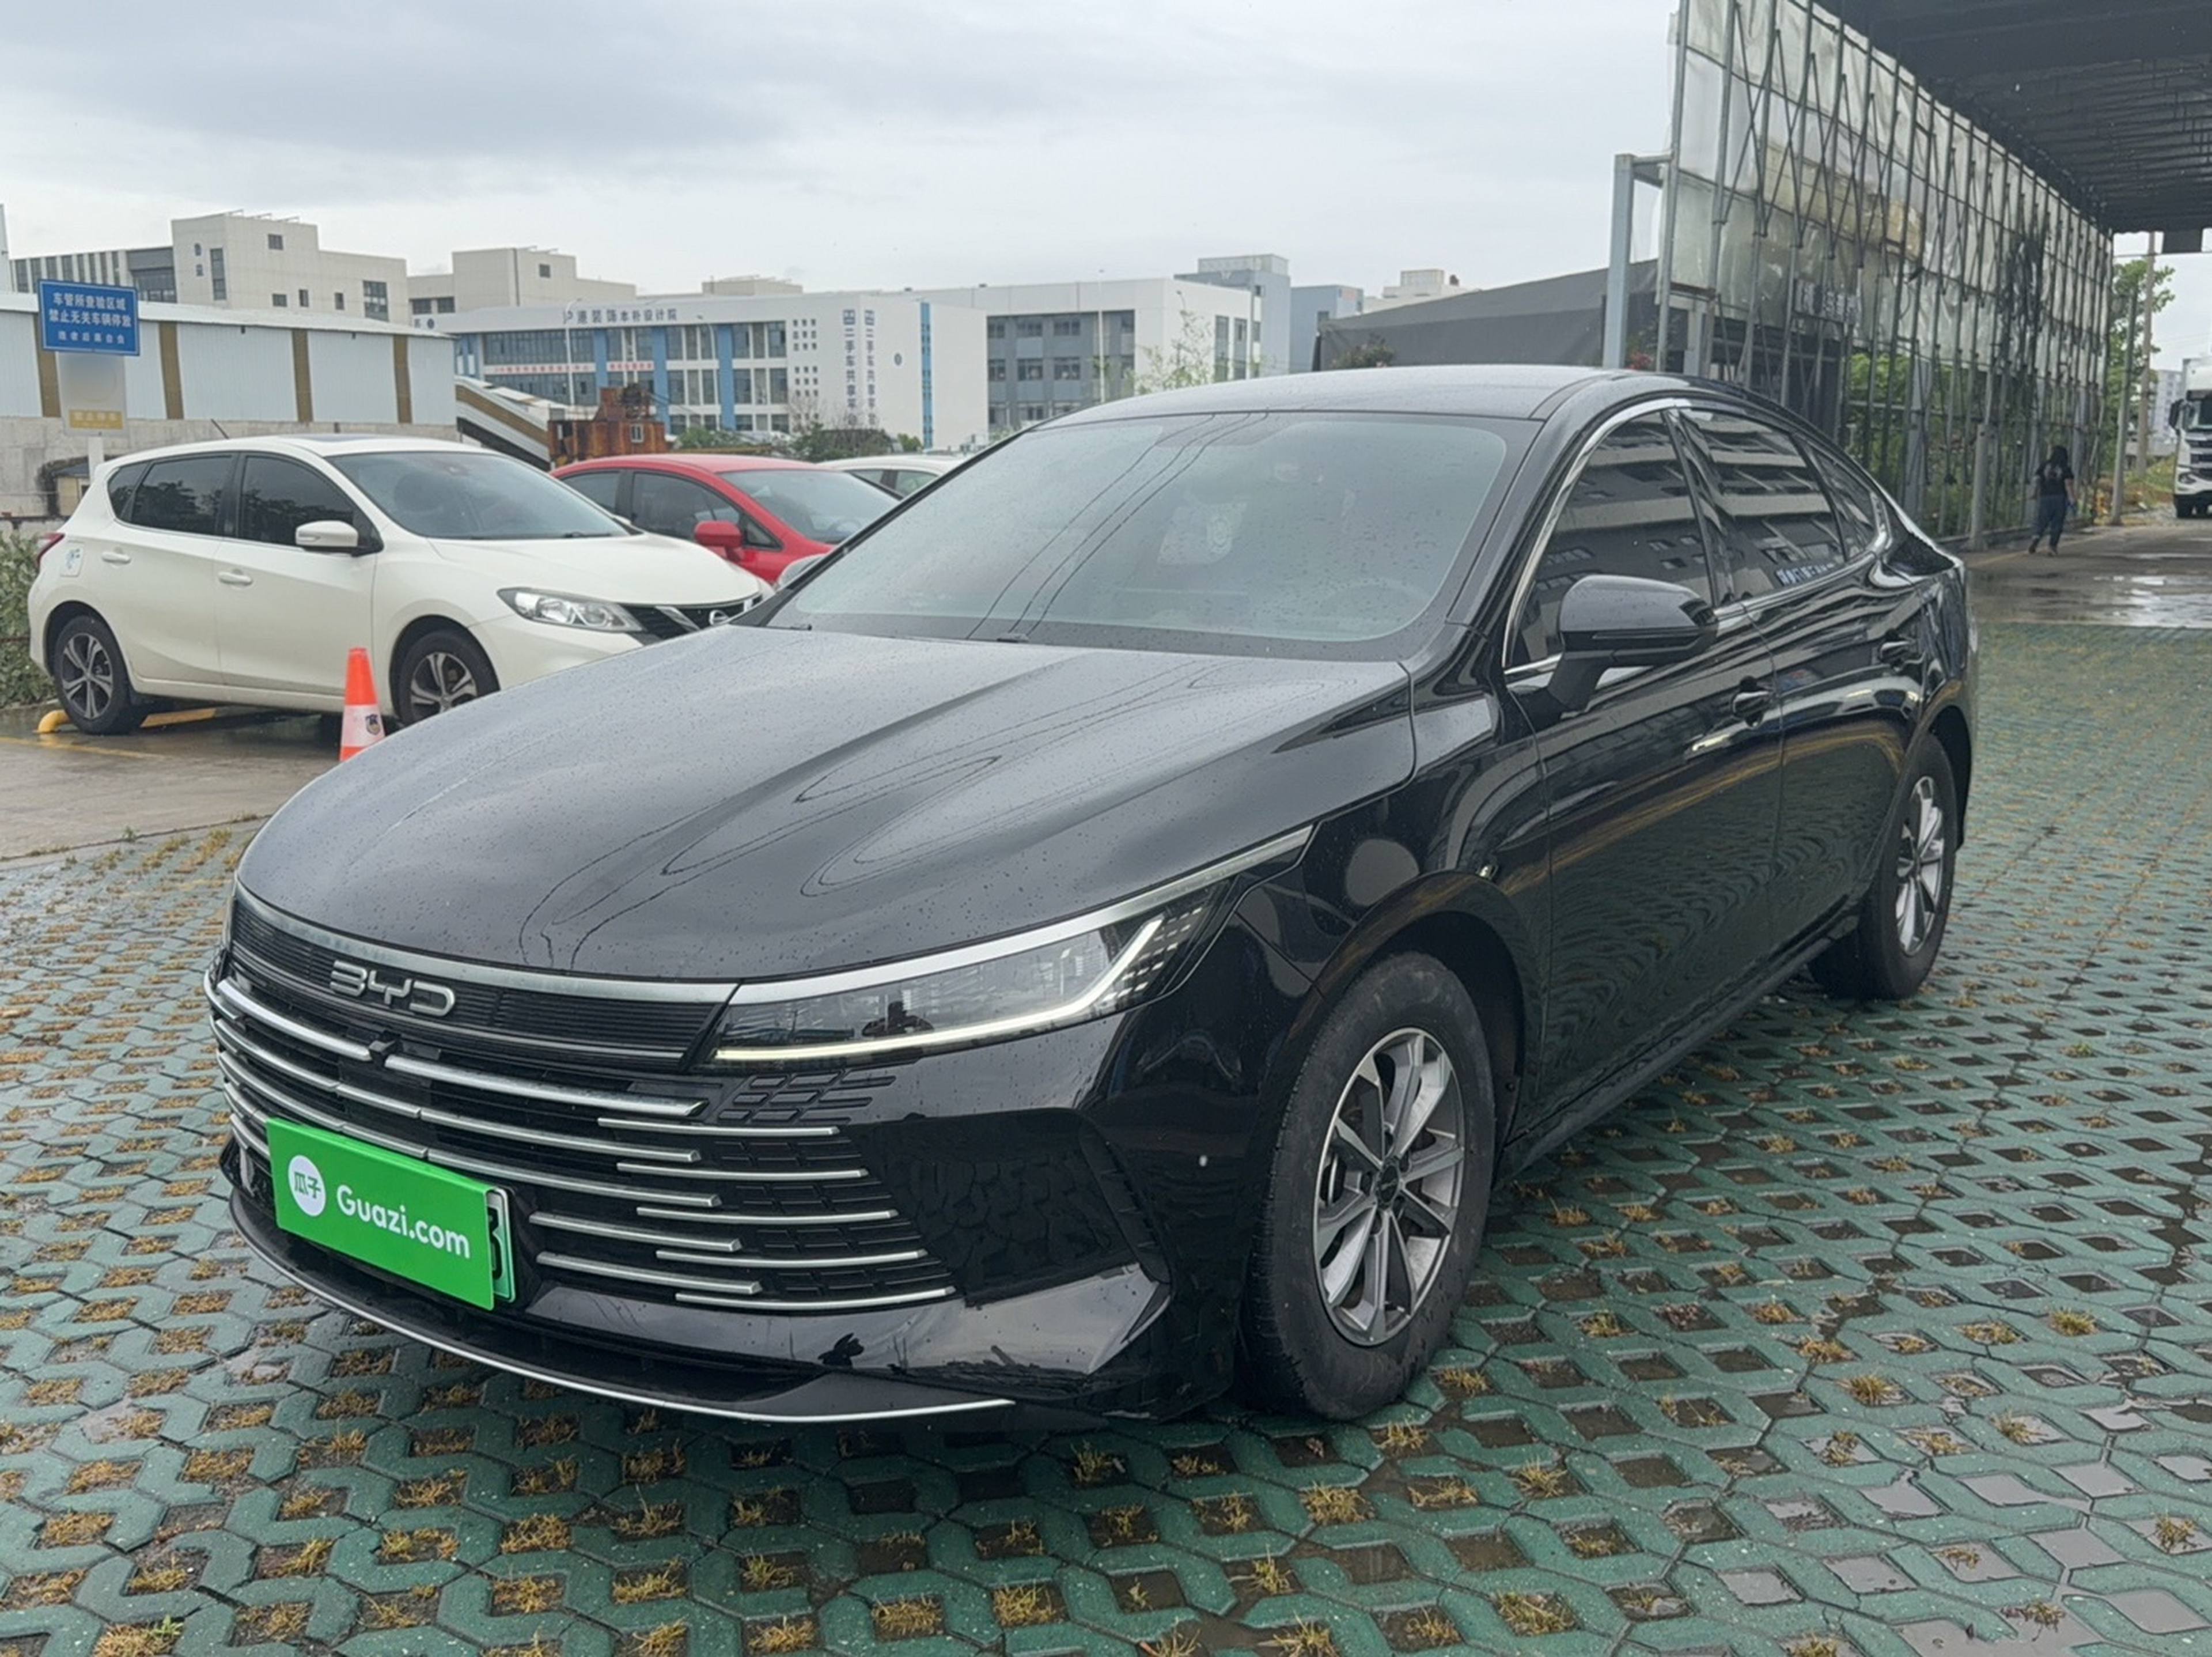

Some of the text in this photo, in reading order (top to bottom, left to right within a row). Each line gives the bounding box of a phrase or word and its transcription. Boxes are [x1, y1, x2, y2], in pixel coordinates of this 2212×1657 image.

[49, 308, 132, 327] 禁止无关车辆停放
[330, 960, 455, 1016] BYD
[294, 1171, 321, 1199] 瓜子
[336, 1185, 470, 1259] Guazi.com
